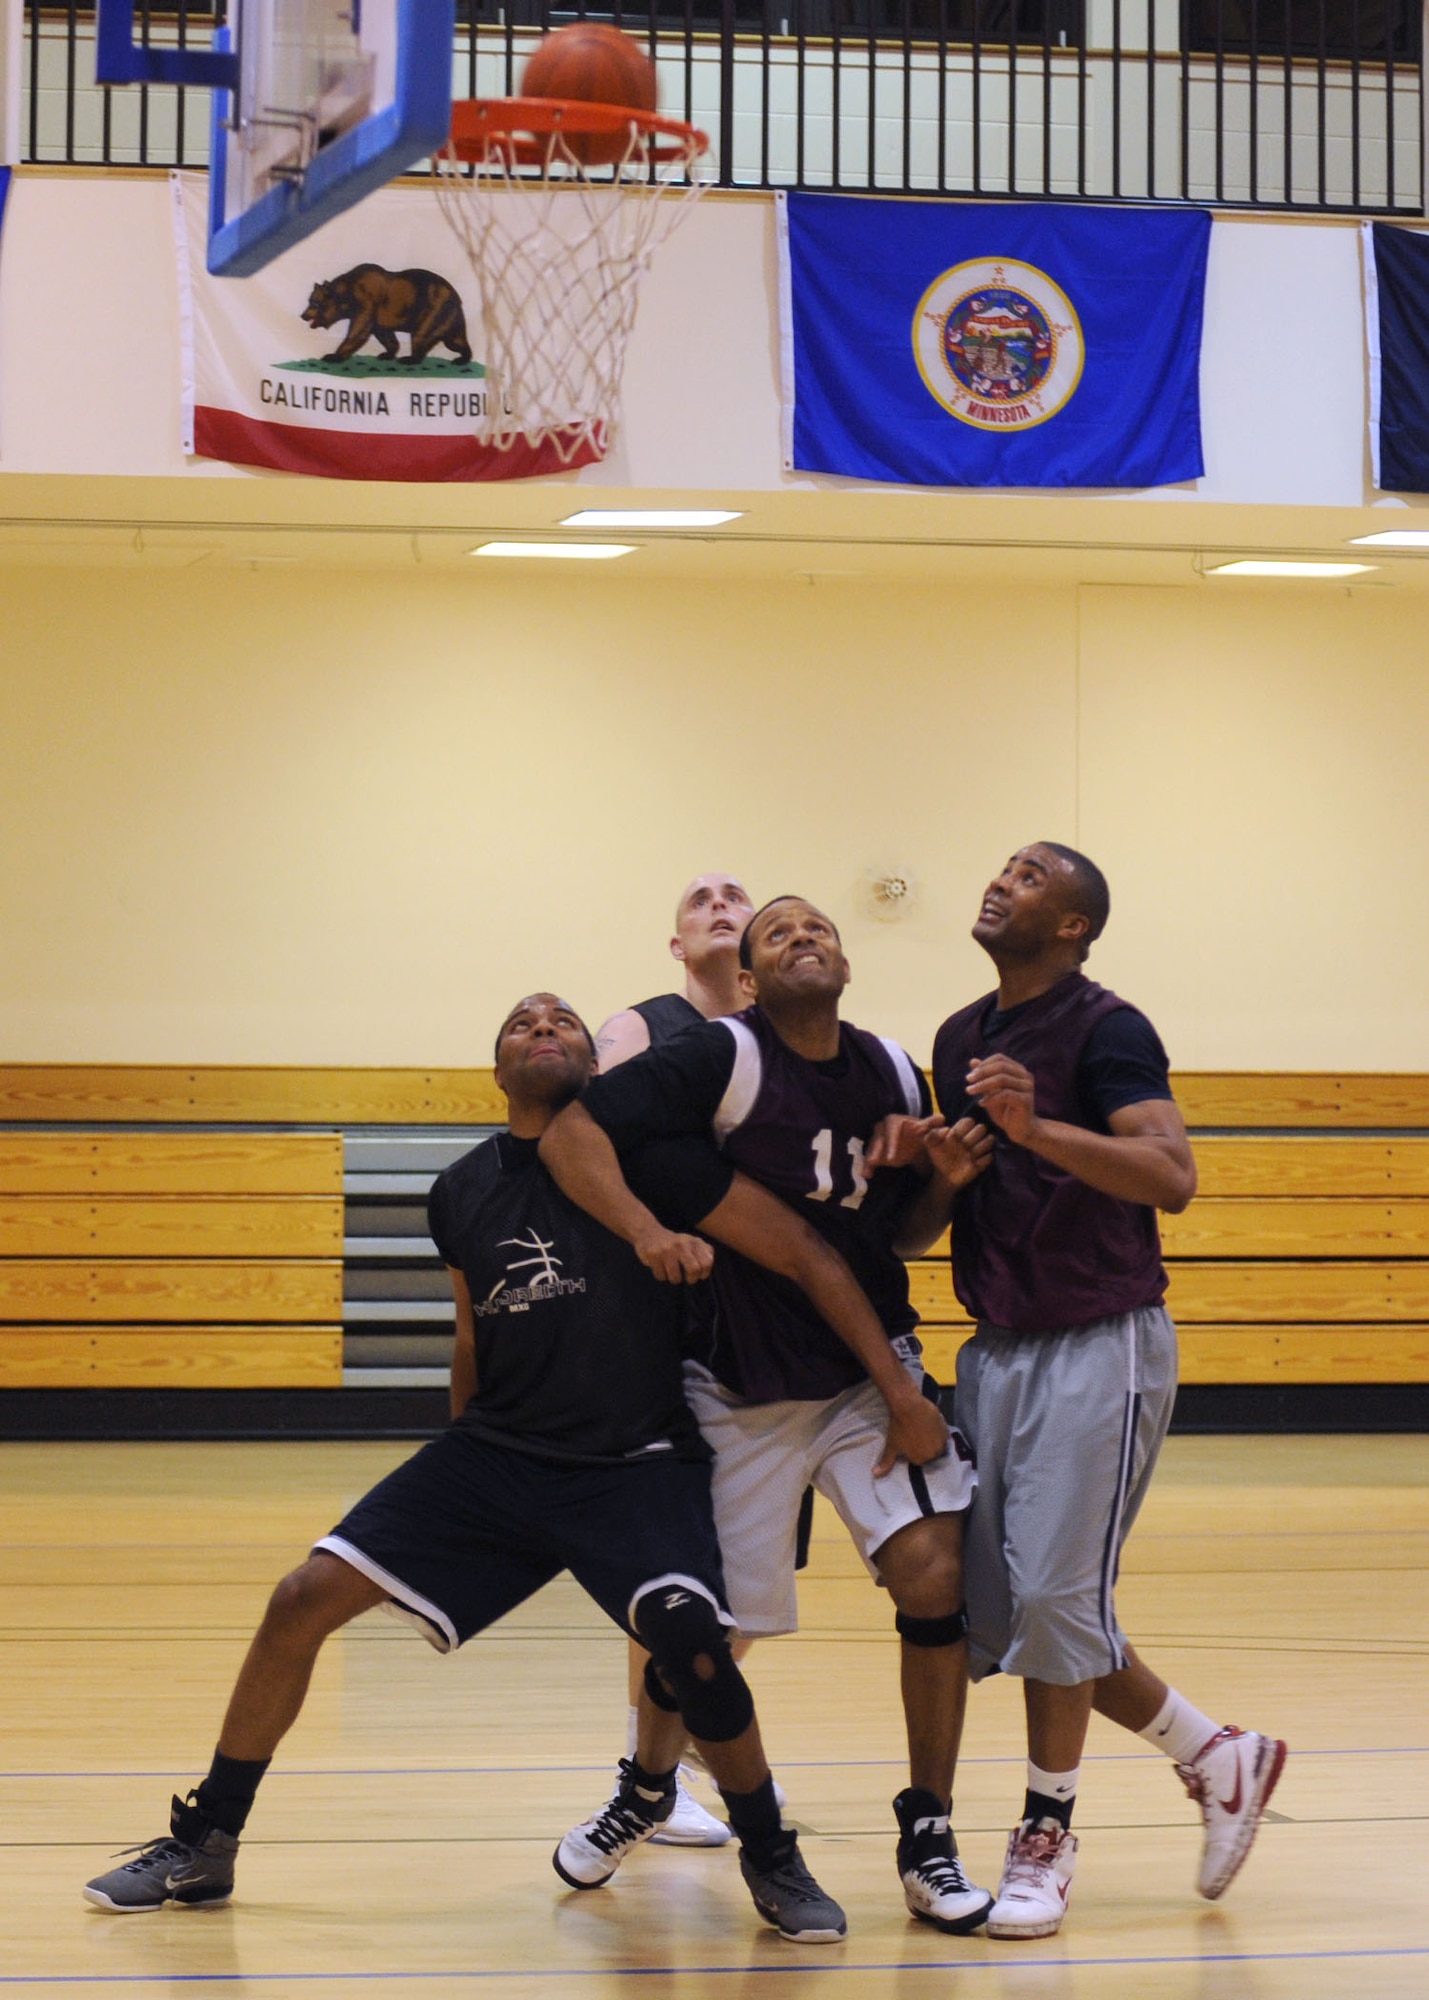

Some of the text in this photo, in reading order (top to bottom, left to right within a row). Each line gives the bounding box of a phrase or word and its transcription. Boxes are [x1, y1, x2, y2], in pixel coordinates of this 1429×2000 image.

[260, 379, 513, 417] CALIFORNIA REPUBL
[965, 400, 1032, 423] MINNESOTA
[805, 1128, 868, 1210] 11
